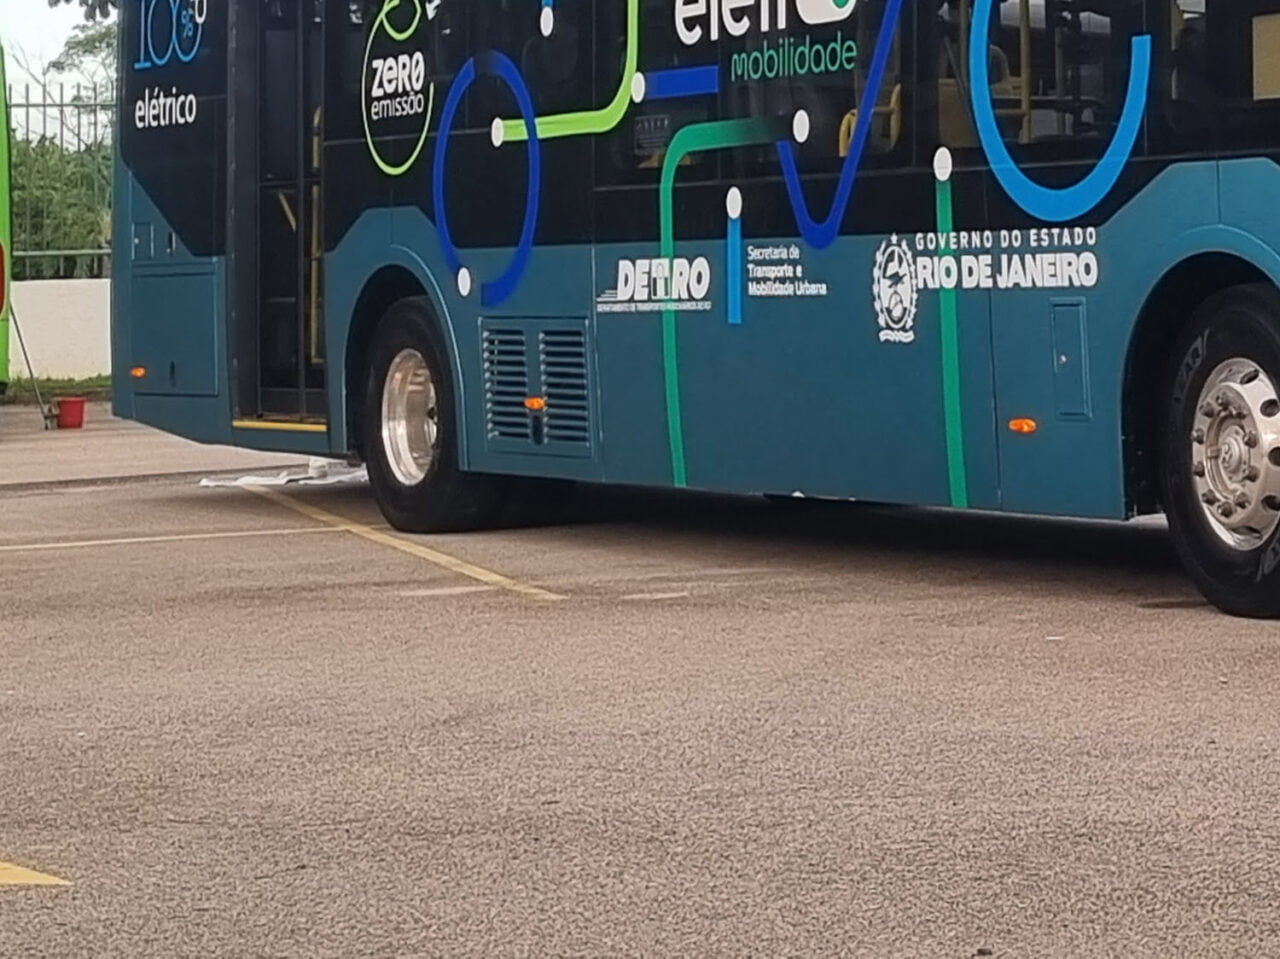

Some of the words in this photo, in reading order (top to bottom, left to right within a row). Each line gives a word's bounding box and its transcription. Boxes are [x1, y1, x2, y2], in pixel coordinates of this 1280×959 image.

[731, 30, 858, 82] mobilidade
[134, 86, 197, 129] elétrico
[371, 91, 425, 121] emissão
[916, 231, 993, 251] GOVERNO
[1000, 230, 1022, 248] DO
[1029, 227, 1096, 247] ESTADO
[916, 255, 958, 289] RIO
[961, 254, 993, 289] DE
[996, 251, 1099, 289] JANEIRO
